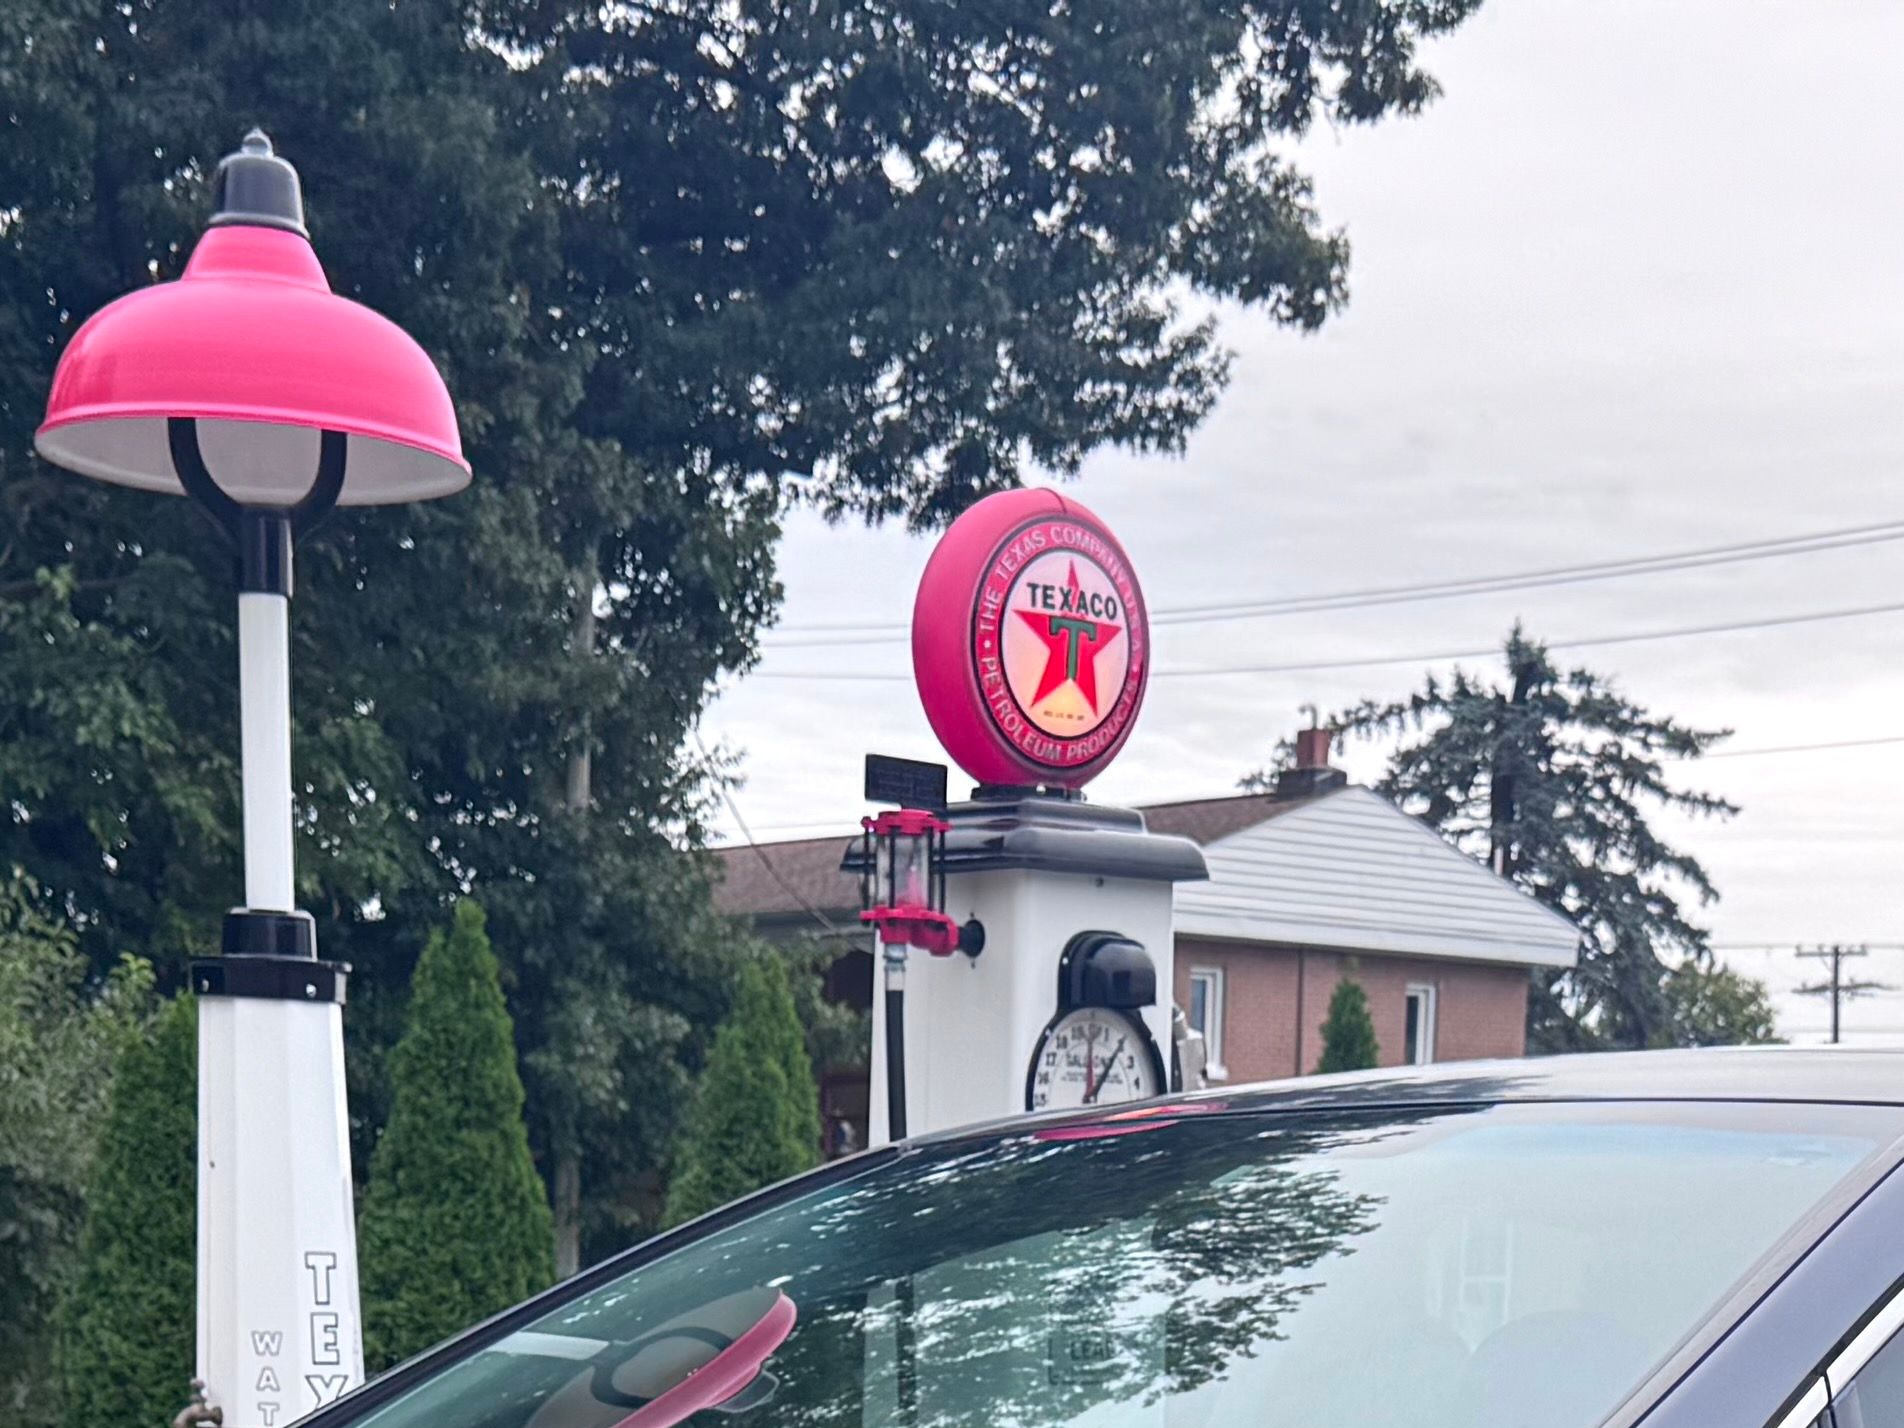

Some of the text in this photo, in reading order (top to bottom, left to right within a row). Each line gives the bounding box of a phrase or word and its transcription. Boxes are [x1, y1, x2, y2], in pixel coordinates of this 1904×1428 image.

[979, 588, 1001, 636] THE
[996, 531, 1046, 582] TEXAS
[1027, 582, 1118, 620] TEXACO
[981, 656, 1063, 760] PETROLEUM
